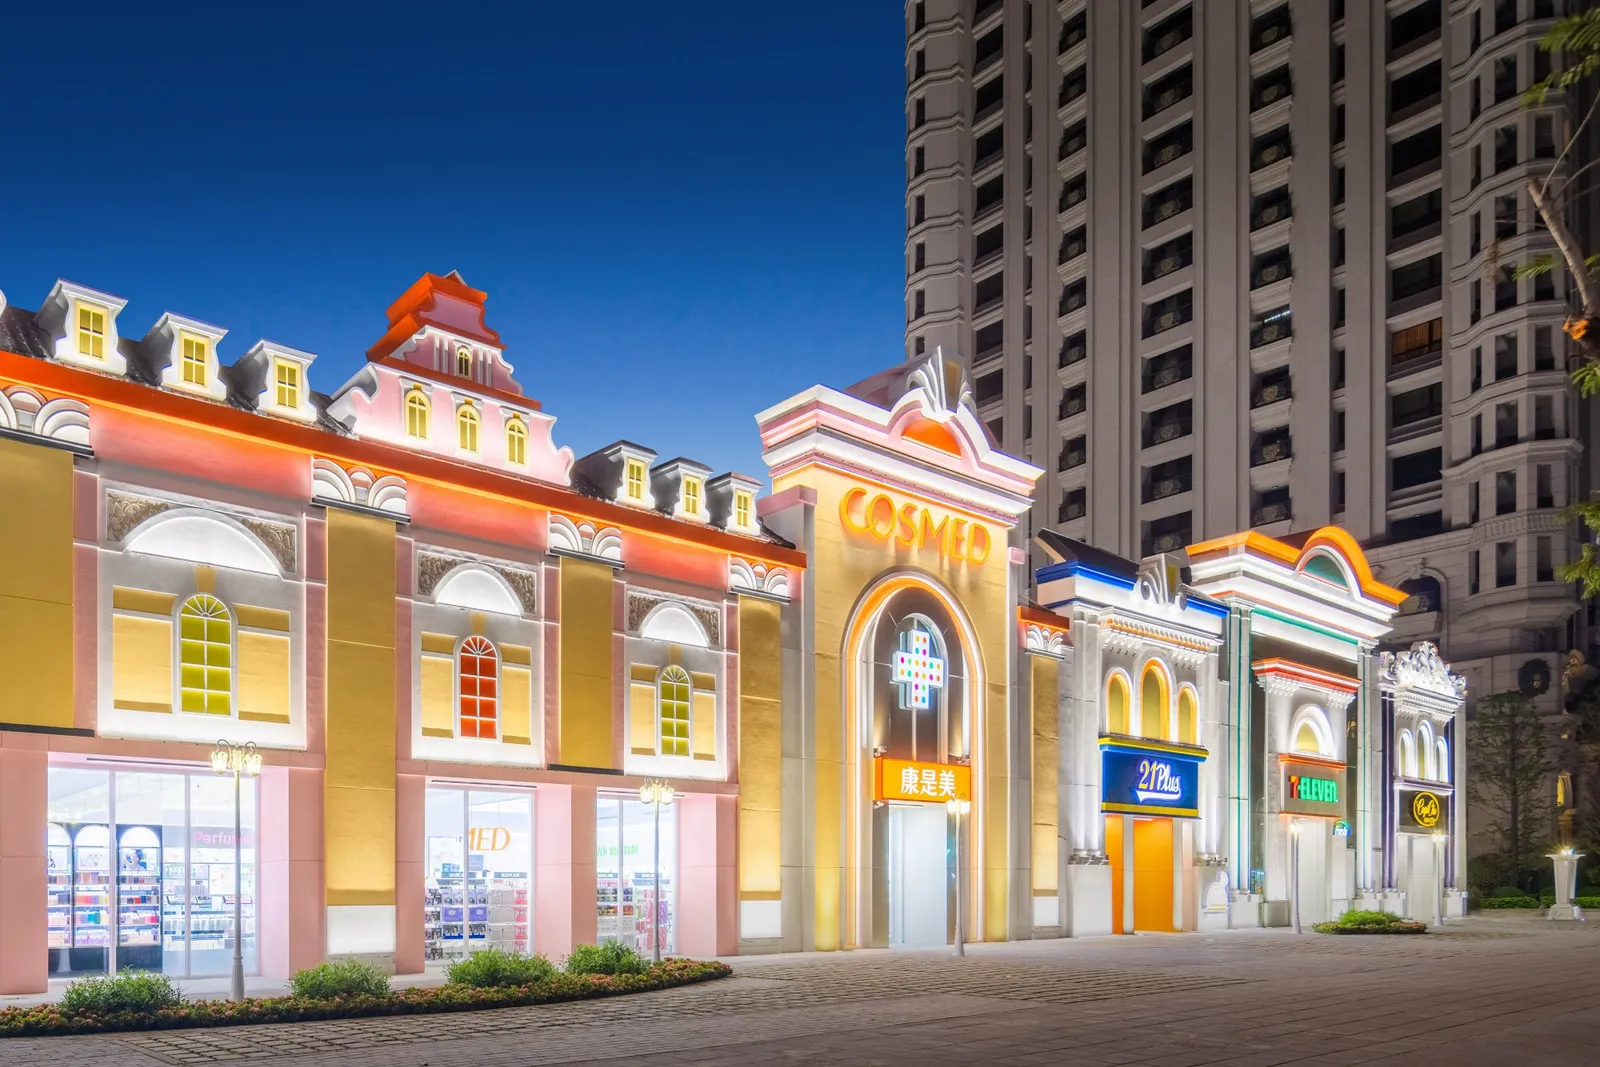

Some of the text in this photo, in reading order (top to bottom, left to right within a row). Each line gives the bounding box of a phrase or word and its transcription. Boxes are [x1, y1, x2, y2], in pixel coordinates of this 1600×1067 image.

[839, 486, 991, 565] COSMED
[900, 766, 956, 797] 康是美
